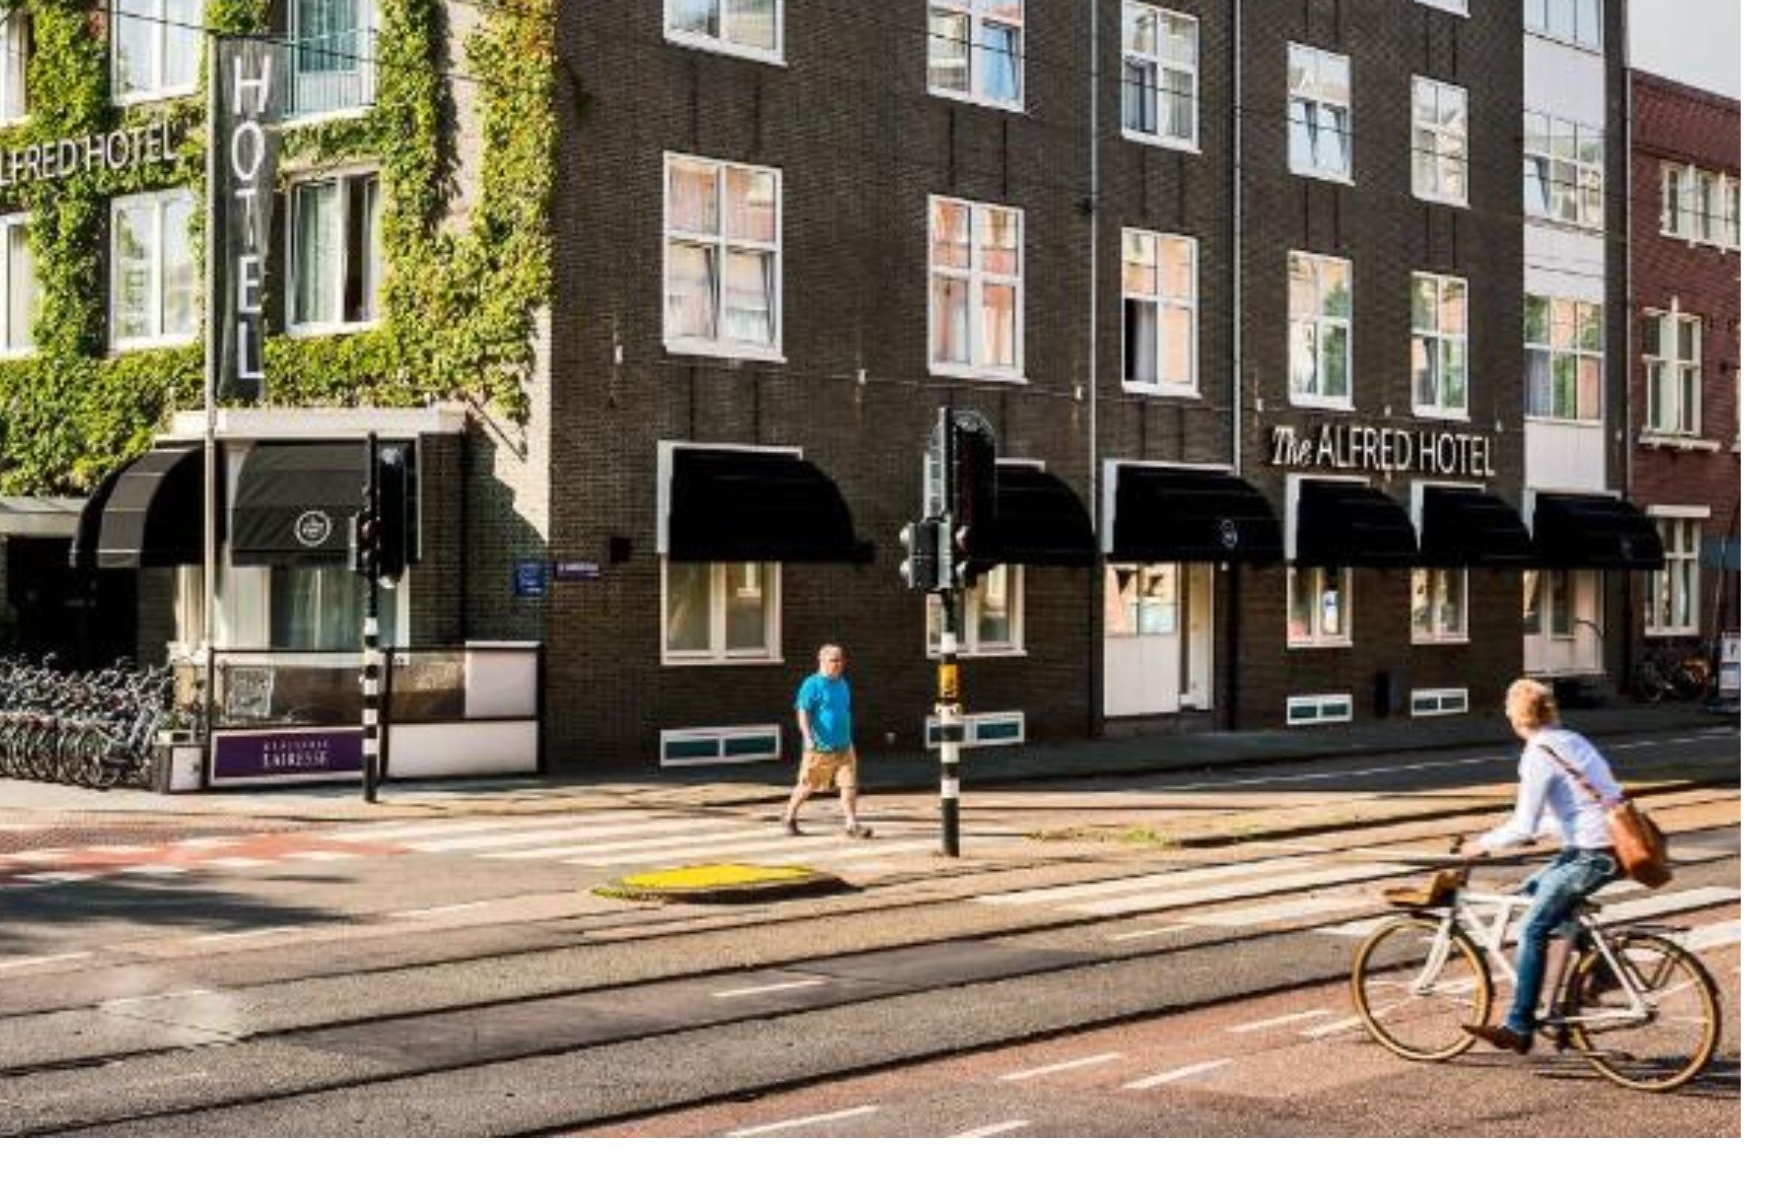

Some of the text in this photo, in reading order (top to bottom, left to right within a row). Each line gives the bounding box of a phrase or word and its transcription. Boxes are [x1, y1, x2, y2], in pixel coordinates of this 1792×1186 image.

[86, 120, 180, 172] HOTEL
[230, 55, 270, 380] HOTEL
[1272, 423, 1496, 477] The ALFRED HOTEL
